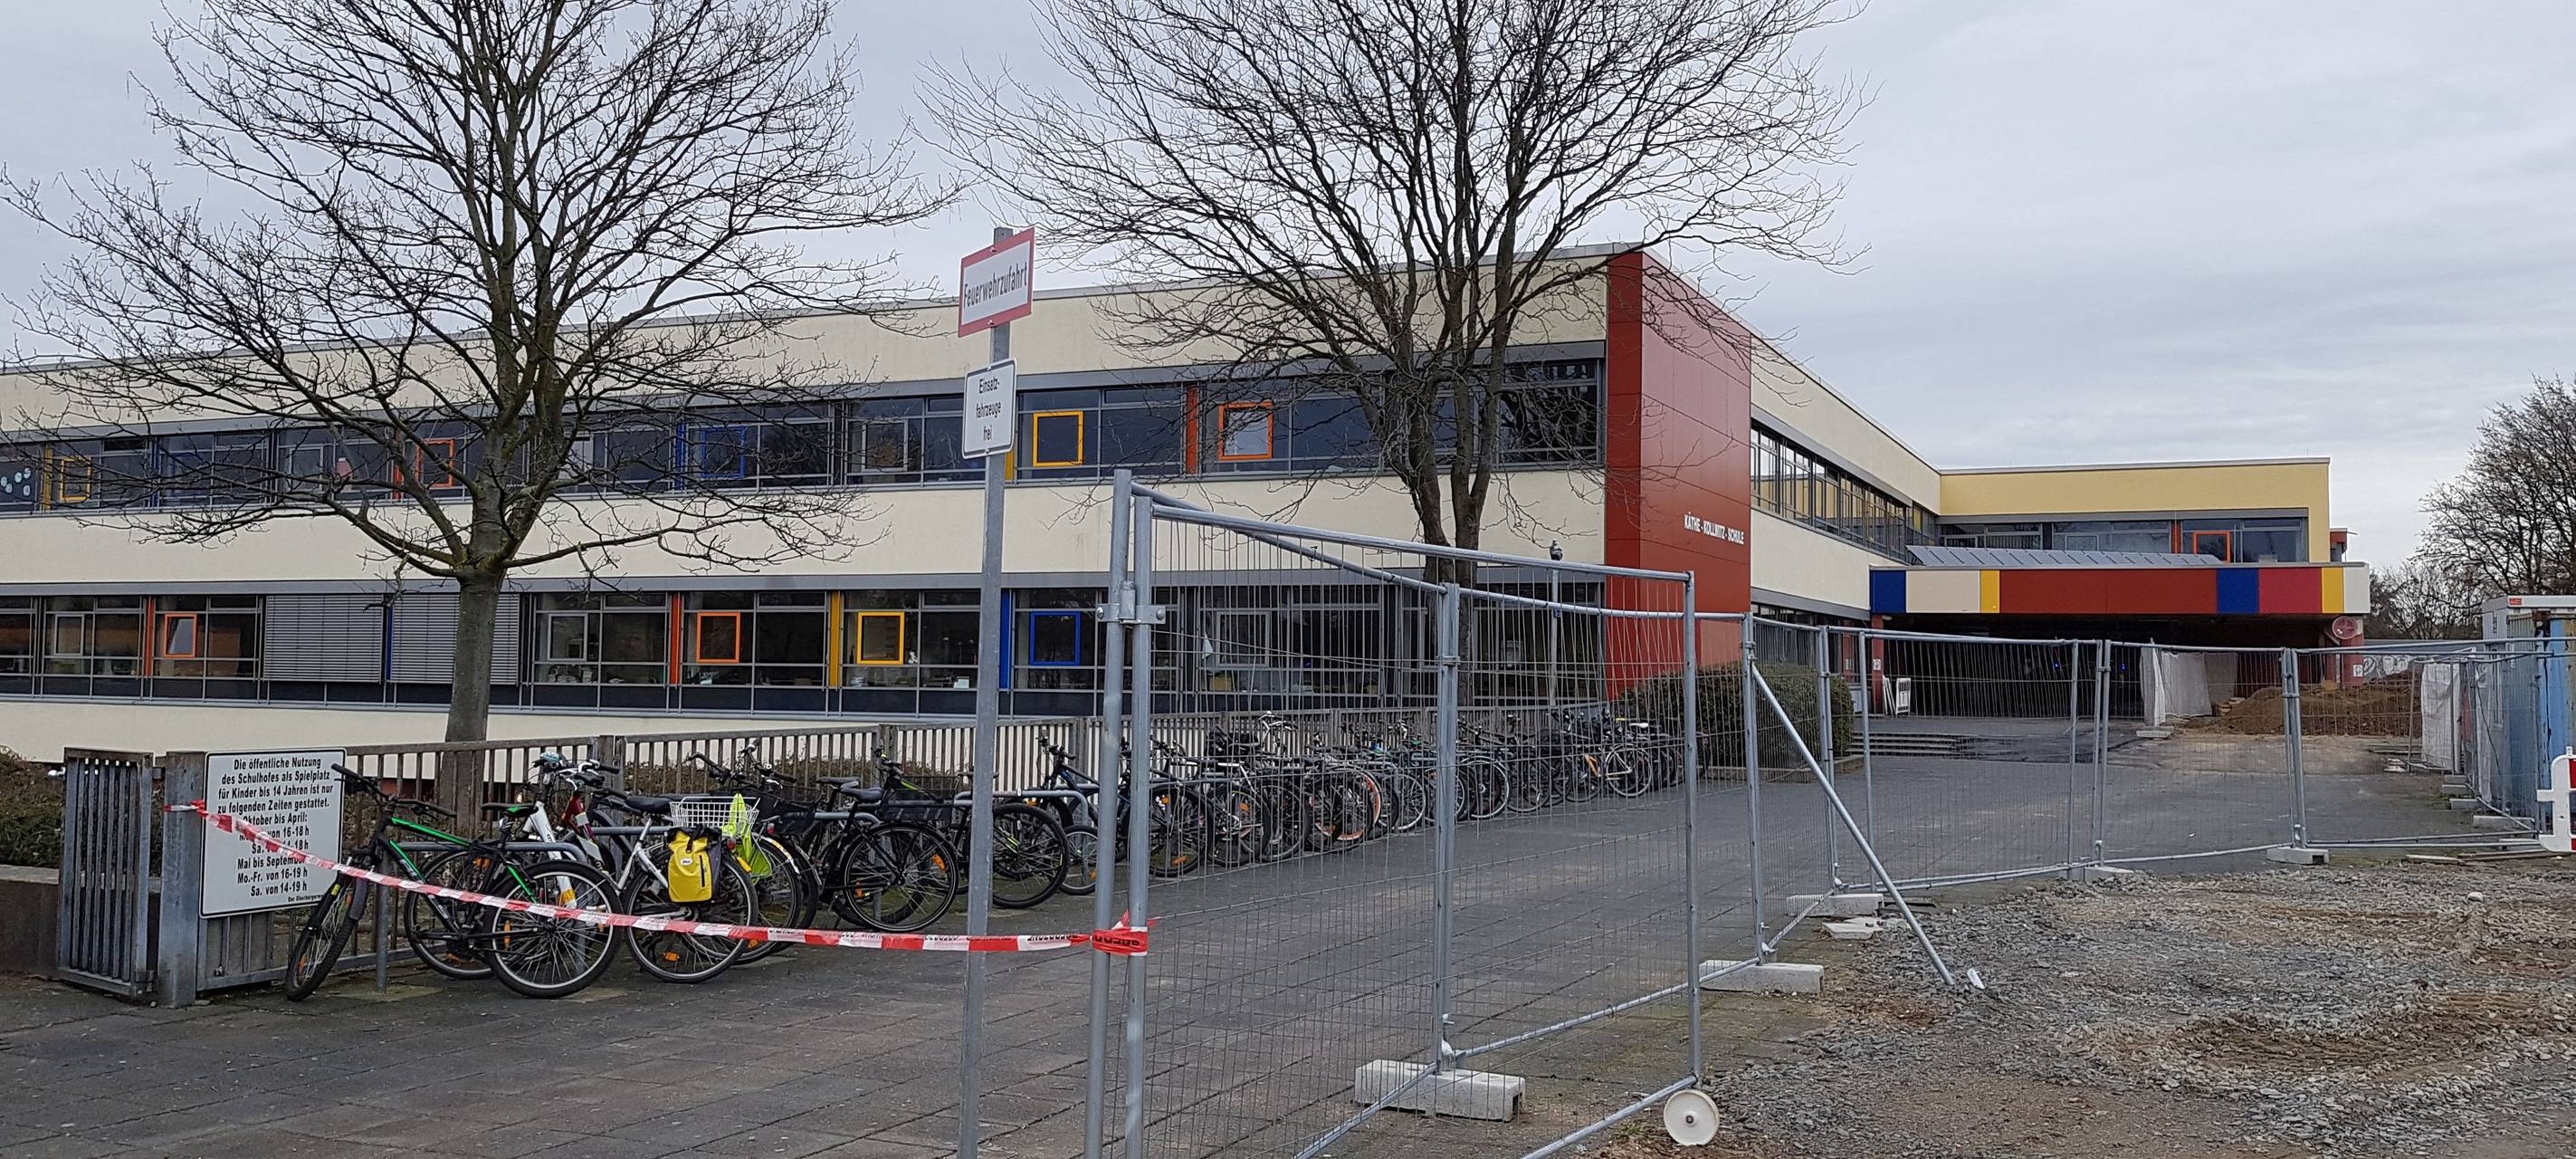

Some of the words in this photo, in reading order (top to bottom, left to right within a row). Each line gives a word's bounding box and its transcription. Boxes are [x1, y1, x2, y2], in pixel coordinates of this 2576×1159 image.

[963, 262, 1027, 310] Feuerwehrzufahrt
[978, 378, 999, 395] Einsatz-
[976, 401, 1001, 420] fahrzeuge
[983, 425, 992, 442] frei
[234, 759, 246, 770] Die
[249, 758, 290, 770] öffentliche
[291, 757, 321, 769] Nutzung
[222, 773, 235, 784] des
[238, 771, 279, 784] Schulhofes
[281, 771, 292, 781] als
[295, 770, 330, 783] Spielplatz
[218, 788, 230, 800] für
[232, 787, 257, 799] Kinder
[259, 786, 270, 797] bis
[272, 785, 281, 796] 14
[283, 784, 308, 795] Jahren
[310, 784, 320, 794] ist
[321, 785, 333, 793] nur
[217, 804, 226, 814] zu
[229, 800, 266, 815] folgenden
[268, 800, 292, 810] Zeiten
[294, 798, 329, 811] gestattet.
[274, 813, 285, 824] bis
[288, 812, 308, 825] April:
[283, 826, 303, 838] 16-18
[305, 825, 309, 836] h
[252, 843, 263, 854] Sa.
[304, 839, 309, 849] h
[237, 857, 251, 869] Mai
[253, 857, 264, 867] bis
[266, 856, 304, 868] Septem
[237, 871, 262, 884] Mo.-Fr.
[266, 872, 279, 881] von
[281, 867, 301, 879] 16-19
[303, 867, 308, 876] h
[251, 886, 262, 896] Sa.
[265, 886, 279, 895] von
[280, 881, 301, 893] 14-19
[302, 881, 307, 891] h
